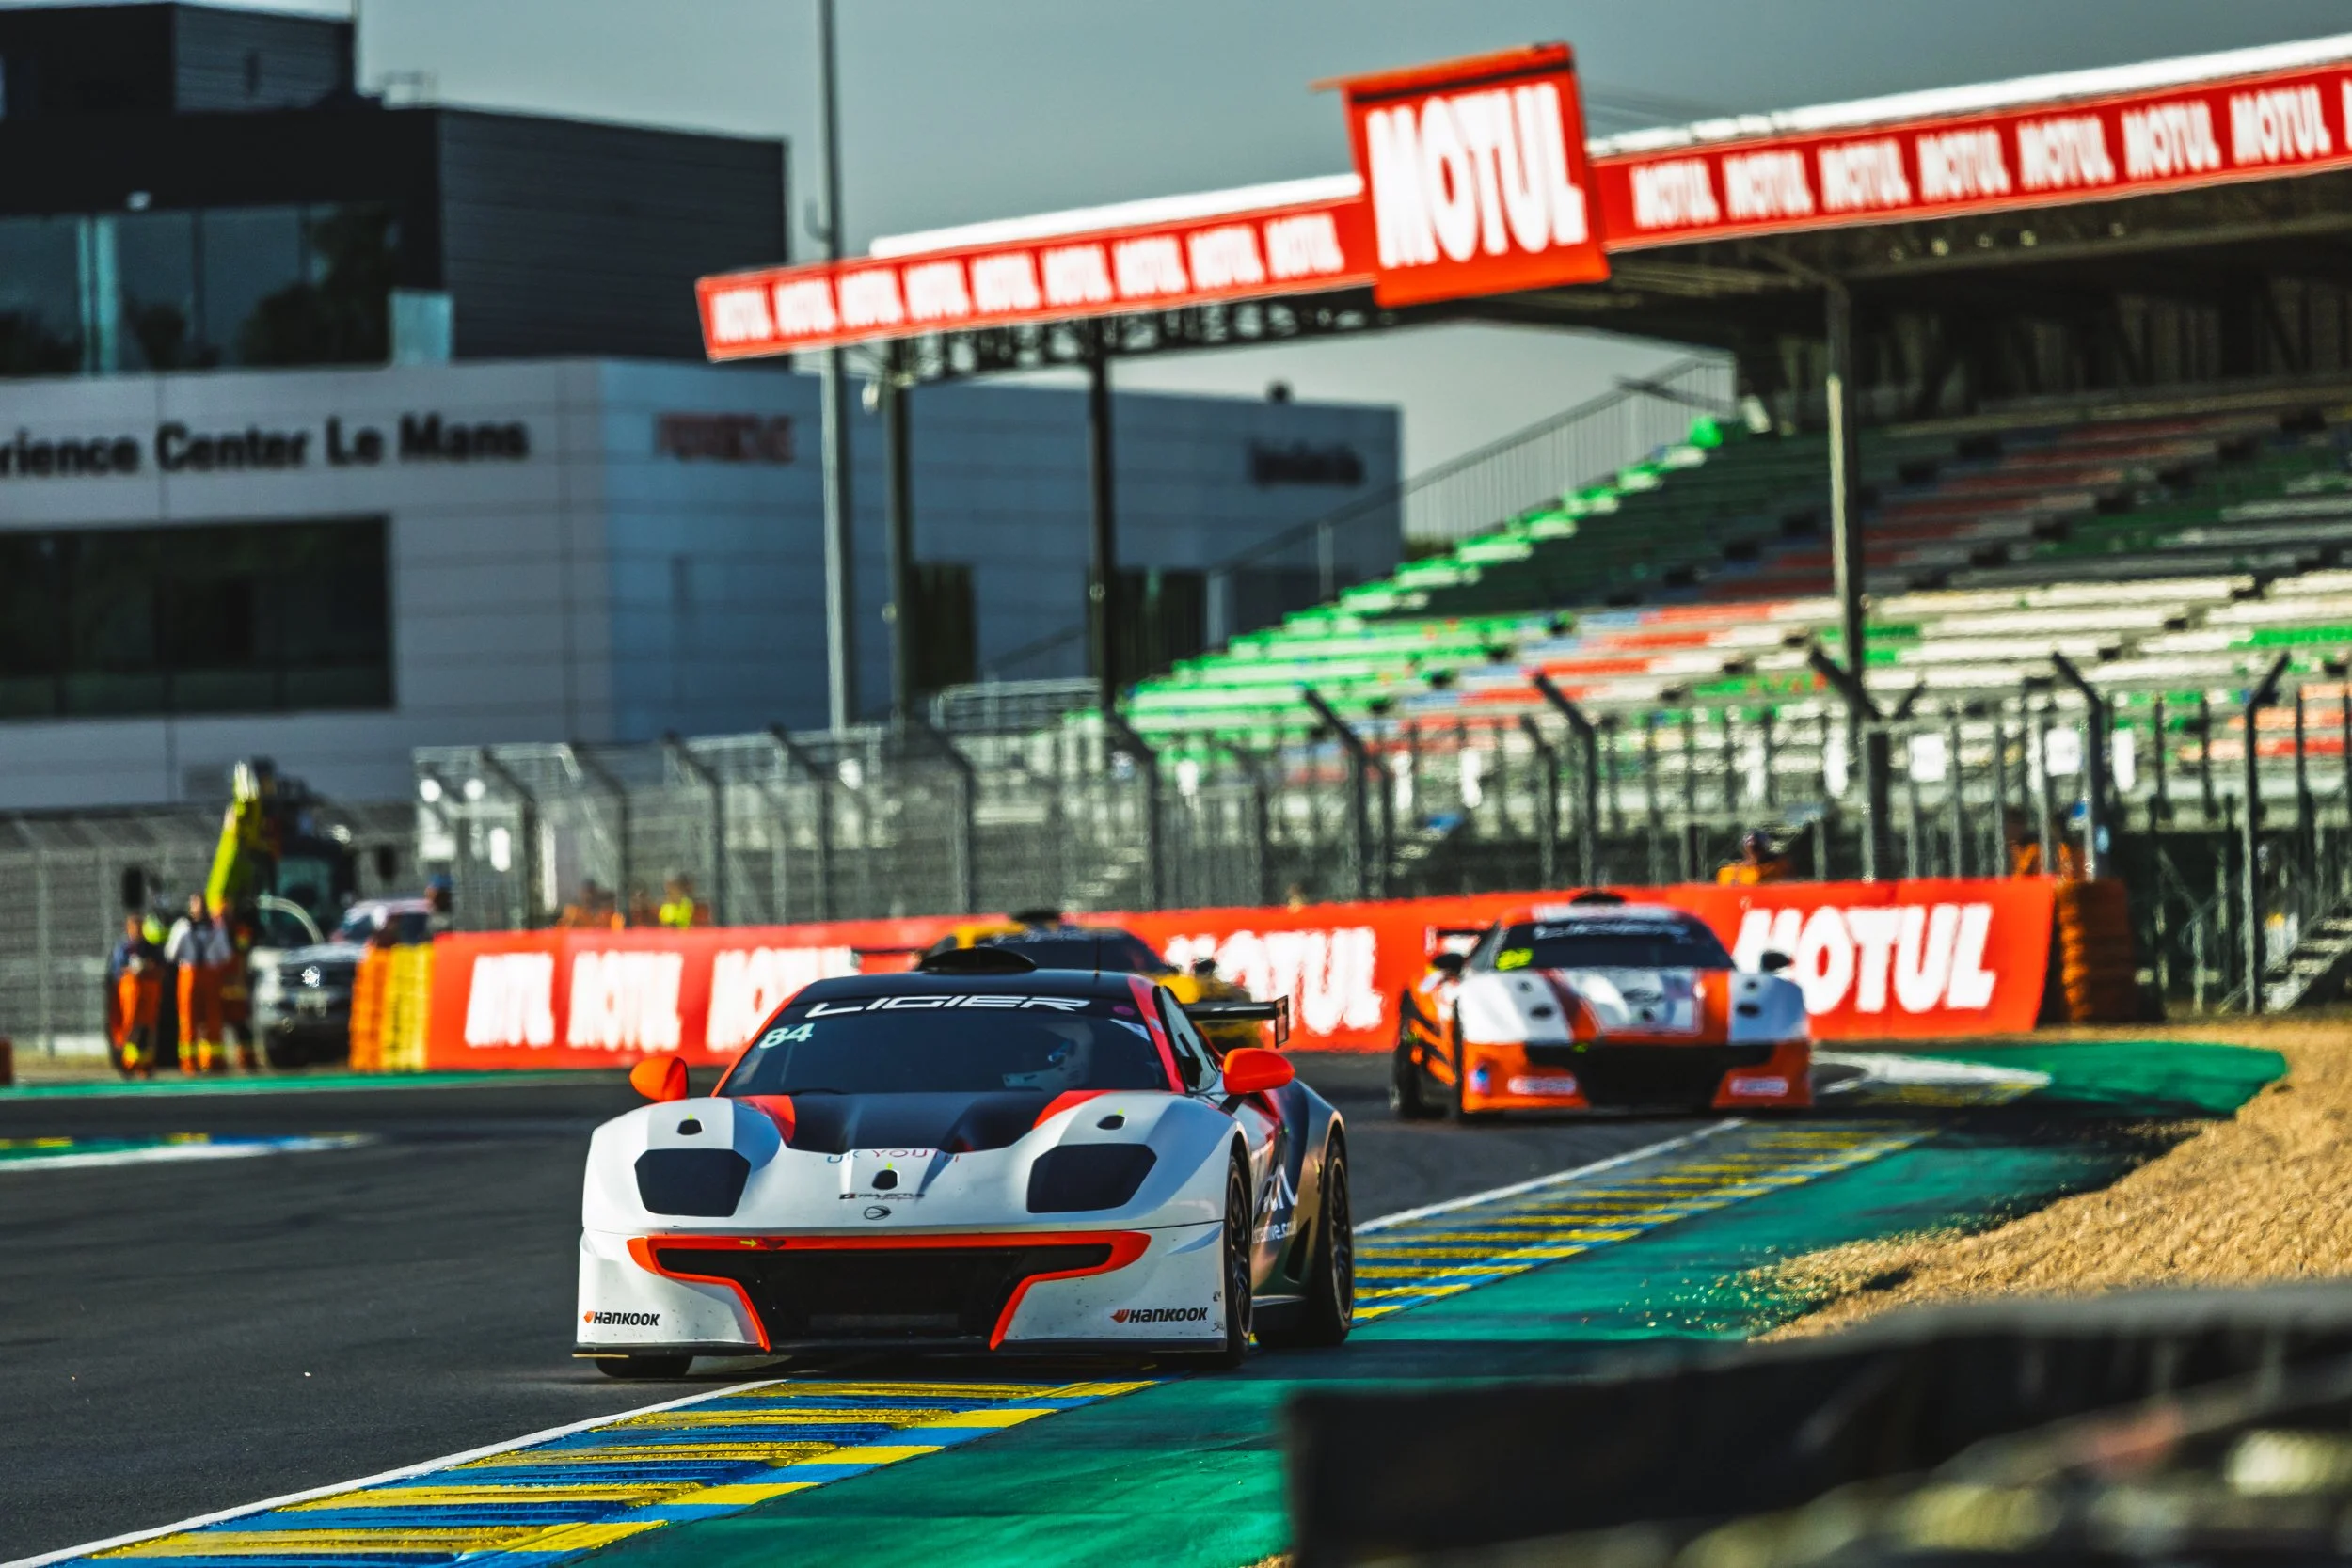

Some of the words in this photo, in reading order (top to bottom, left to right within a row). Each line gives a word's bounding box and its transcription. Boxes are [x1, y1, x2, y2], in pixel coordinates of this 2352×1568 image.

[1820, 142, 1910, 206] MOTUL
[1918, 131, 2009, 196] MOTUL
[2018, 119, 2113, 183] MOTUL
[2122, 104, 2219, 175] MOTUL
[2231, 87, 2331, 159] MOTUL
[1367, 83, 1587, 269] MOTUL
[157, 420, 308, 470] Center
[326, 415, 382, 466] Le
[400, 411, 529, 463] Mans
[805, 994, 1090, 1019] LIGIER
[759, 1022, 815, 1050] 84
[872, 1148, 961, 1164] YOUTH
